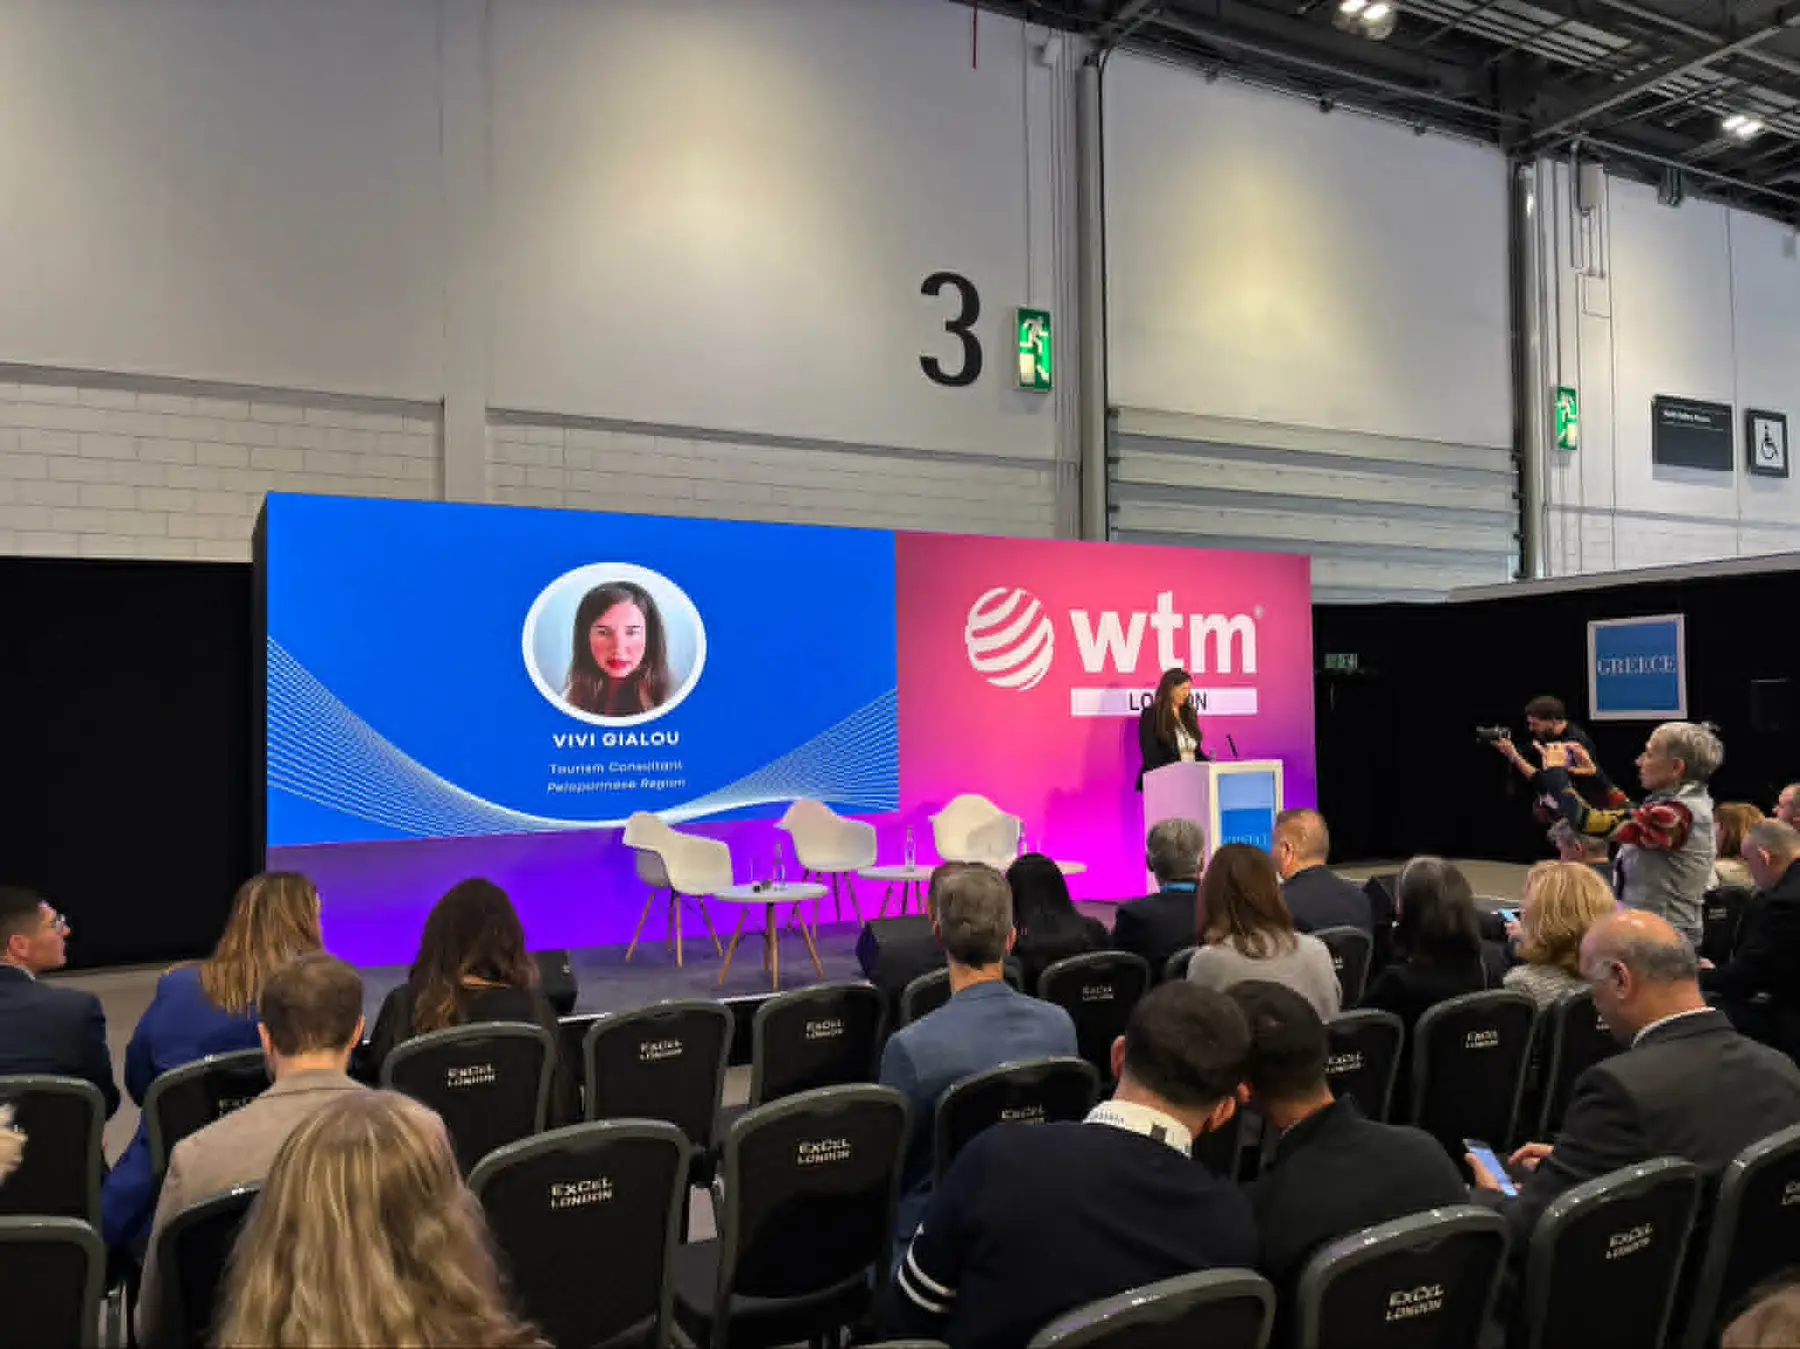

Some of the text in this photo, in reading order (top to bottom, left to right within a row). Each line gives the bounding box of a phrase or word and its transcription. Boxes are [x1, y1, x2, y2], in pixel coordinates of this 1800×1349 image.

[920, 272, 982, 387] 3
[1069, 590, 1256, 674] wtm
[1130, 692, 1207, 710] LON
[552, 731, 680, 748] VIVI GIALOU
[549, 759, 682, 775] Tourism Consultant
[547, 778, 686, 794] Peloponnese Region
